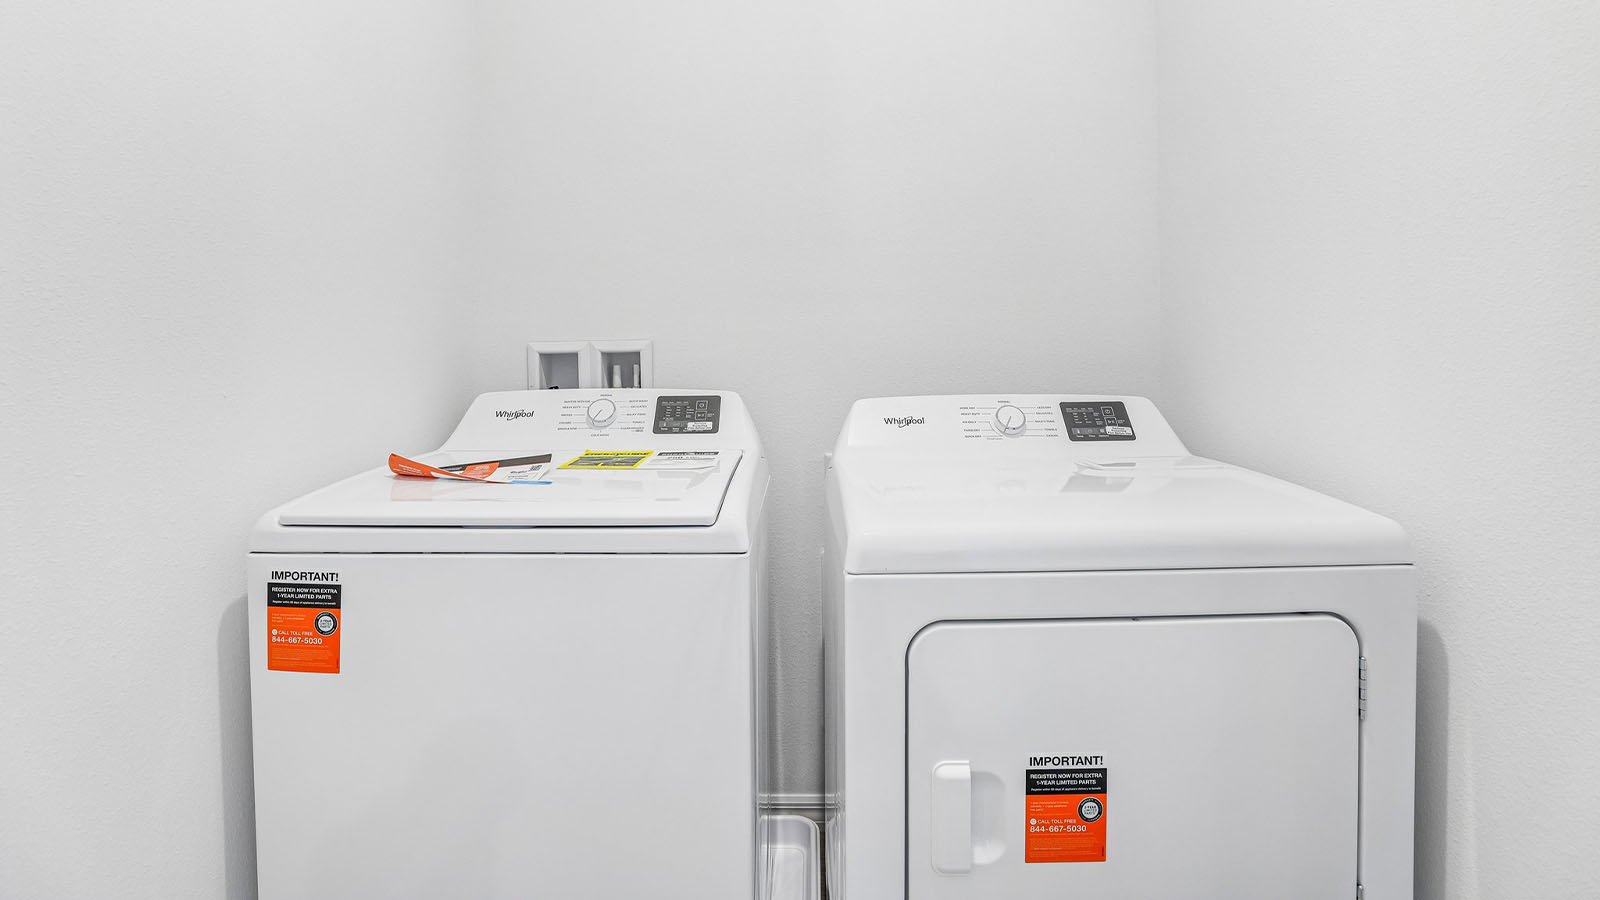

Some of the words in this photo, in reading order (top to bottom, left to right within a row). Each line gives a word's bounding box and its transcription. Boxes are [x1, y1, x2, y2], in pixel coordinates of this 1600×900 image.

[495, 409, 534, 421] Whirlpool
[884, 415, 925, 428] Whirlpool
[271, 570, 339, 583] IMPORTANT!
[271, 636, 323, 645] 844-667-5030
[1029, 755, 1104, 767] IMPORTANT!
[1029, 825, 1087, 833] 844-667-5030
